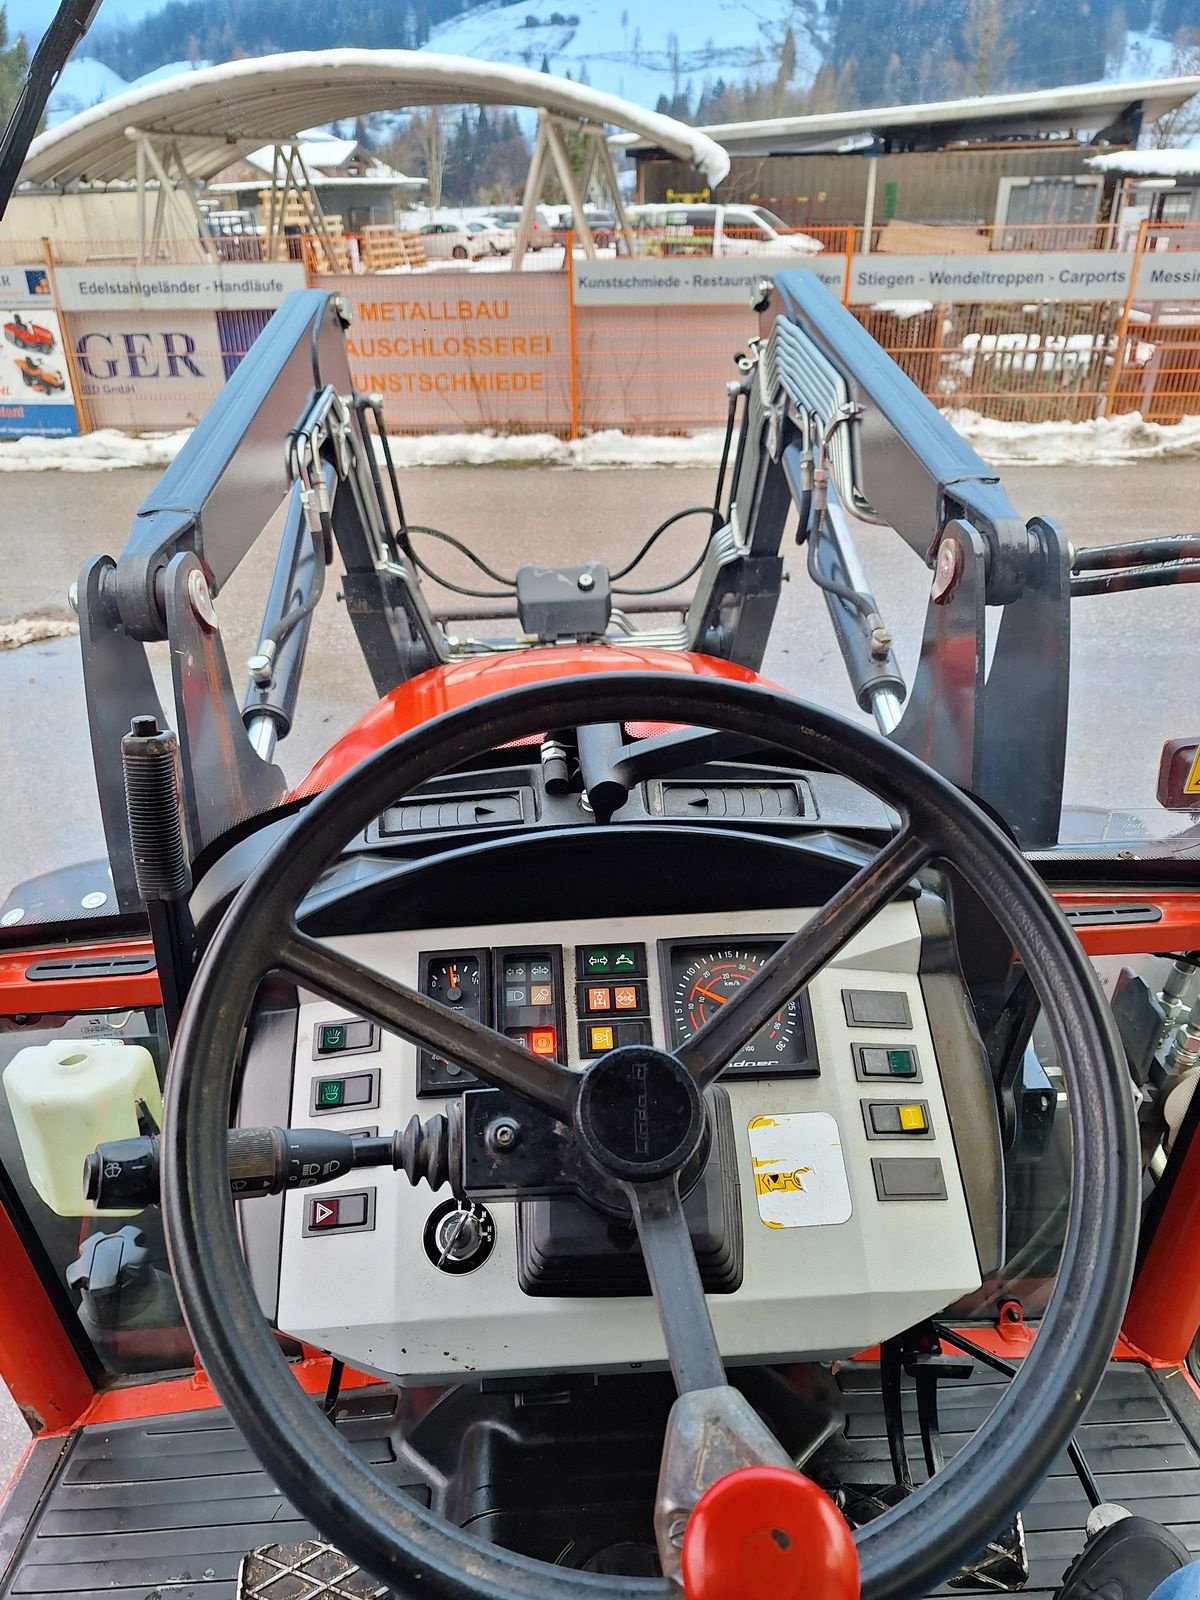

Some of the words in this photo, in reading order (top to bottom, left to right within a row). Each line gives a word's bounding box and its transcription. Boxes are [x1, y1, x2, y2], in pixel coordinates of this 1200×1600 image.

[578, 275, 680, 288] Kunstschmiede
[857, 271, 914, 289] Stiegen
[928, 270, 1044, 288] Wendeltreppen
[1059, 269, 1126, 286] Carports
[79, 279, 201, 297] Edelstahlgeländer
[214, 279, 284, 294] Handläufe
[358, 299, 510, 321] METALLBAU
[345, 335, 552, 357] AUSCHLOSSEREI
[75, 332, 206, 380] GER
[352, 371, 545, 392] UNSTSCHMIEDE
[724, 951, 733, 959] 15
[686, 967, 696, 977] 10
[702, 971, 711, 979] 20
[787, 1001, 796, 1011] 25
[775, 1040, 786, 1052] 30
